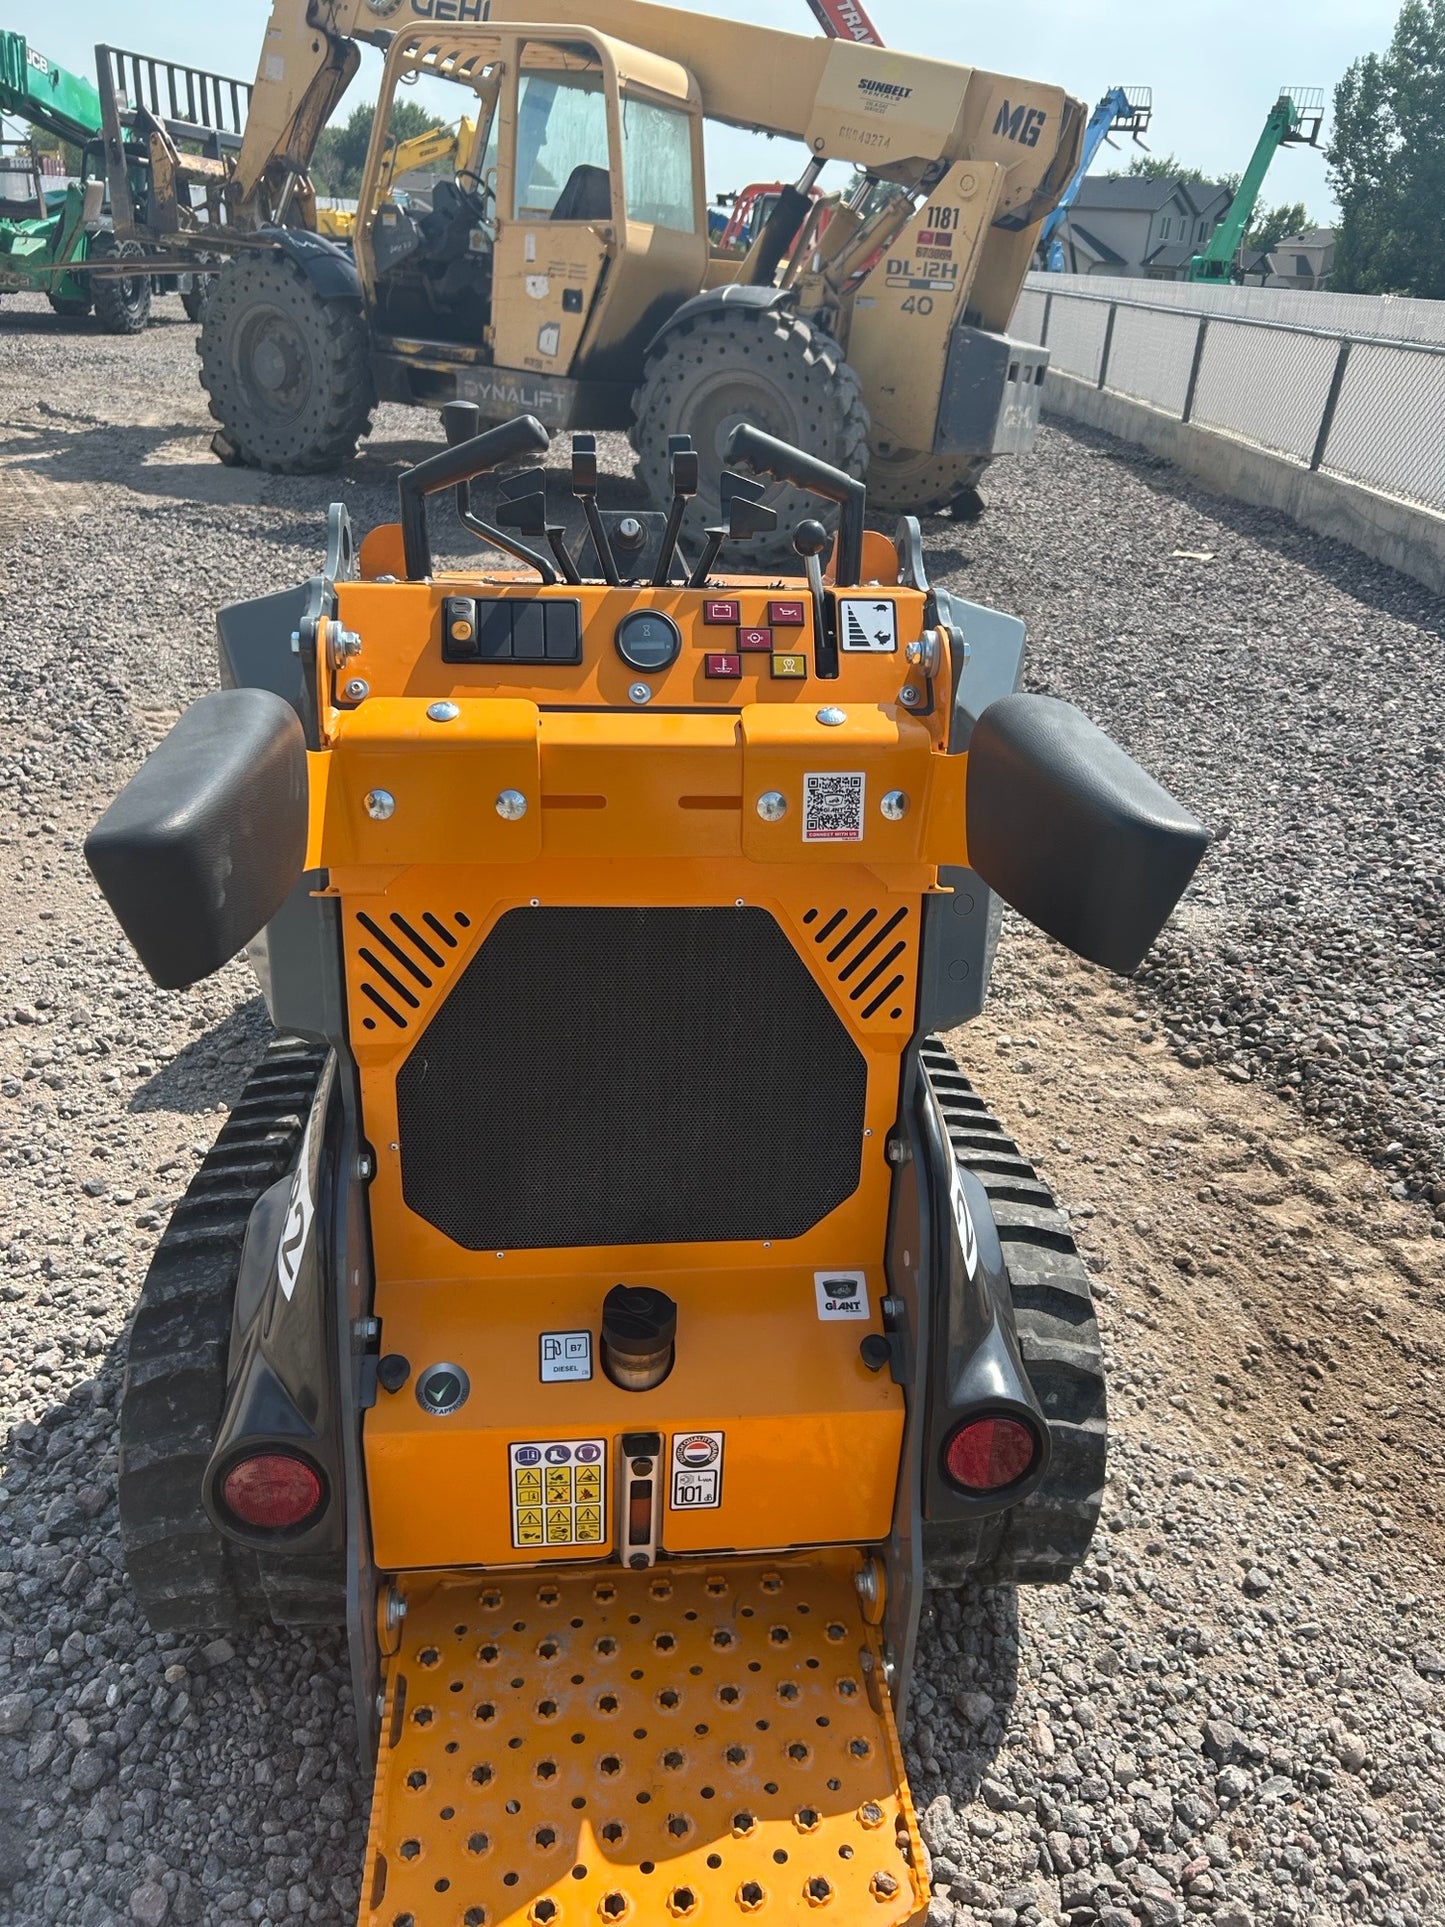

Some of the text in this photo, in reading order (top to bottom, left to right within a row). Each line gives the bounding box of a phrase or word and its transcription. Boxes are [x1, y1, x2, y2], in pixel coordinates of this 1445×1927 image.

[26, 48, 49, 74] JCB
[858, 78, 913, 98] SUNBELT
[861, 89, 902, 102] RENTALS
[992, 99, 1047, 148] MG
[927, 206, 960, 230] 1181
[886, 259, 958, 279] DL-12H
[901, 296, 934, 316] 40
[463, 380, 566, 411] DYNALIFT
[570, 1343, 582, 1352] B7
[553, 1365, 579, 1373] DIESEL
[683, 1435, 712, 1447] QUALITY
[707, 1440, 719, 1463] BRAND
[678, 1485, 702, 1503] 101
